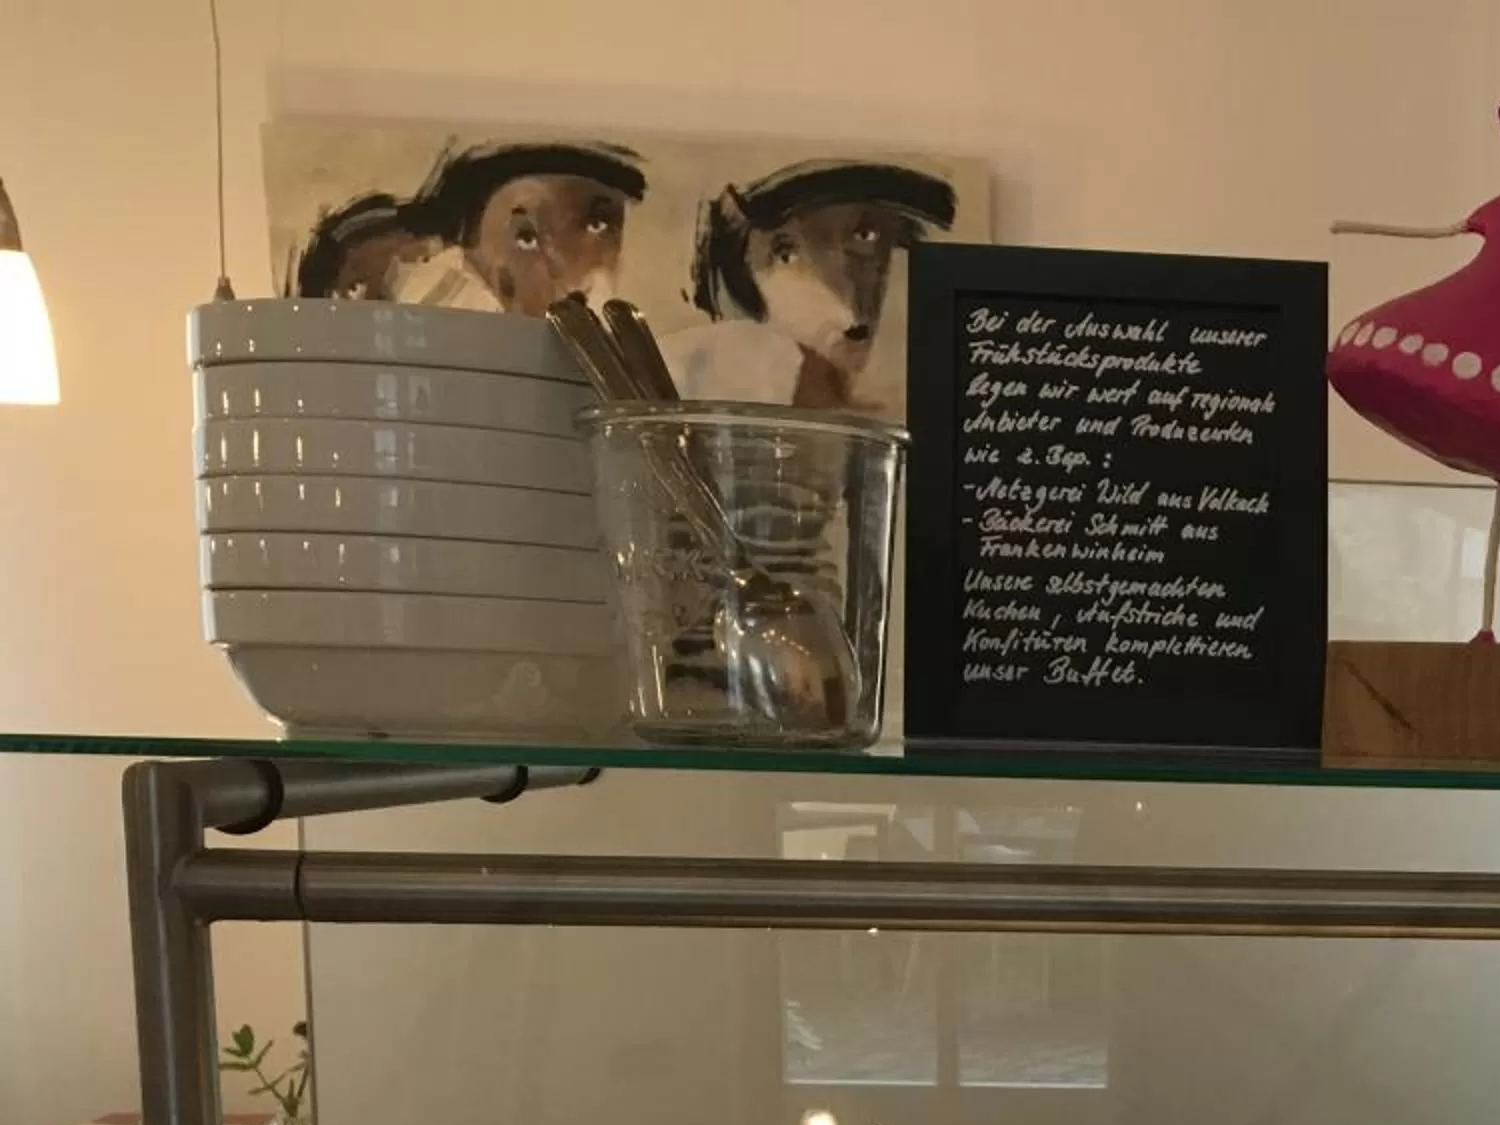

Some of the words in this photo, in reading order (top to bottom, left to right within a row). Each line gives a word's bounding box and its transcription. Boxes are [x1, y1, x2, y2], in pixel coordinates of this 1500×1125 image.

[966, 308, 1008, 332] Bei
[1016, 310, 1055, 334] der
[1064, 312, 1169, 343] Auswahl
[1189, 326, 1268, 348] unserer
[968, 339, 1203, 376] Frühstücksprodukte
[1038, 379, 1080, 400] wir
[1147, 386, 1191, 411] auf
[963, 407, 1062, 433] Anbieter
[1075, 416, 1121, 436] und
[1131, 415, 1253, 444] Produzenten
[964, 443, 1000, 463] wie
[1097, 478, 1150, 505] Wild
[1157, 491, 1192, 509] aus
[1197, 486, 1270, 514] Volkach
[1085, 513, 1169, 537] Schmitt
[1180, 523, 1219, 541] aus
[979, 534, 1165, 564] Frankenwinheim
[963, 568, 1034, 592] Unsere
[1045, 573, 1226, 606] selbstgemachten
[1076, 601, 1199, 629] Aufstriche
[1215, 606, 1265, 631] und
[962, 628, 1088, 657] Konfitüren
[1105, 631, 1252, 660] komplettieren
[963, 662, 1029, 682] unser
